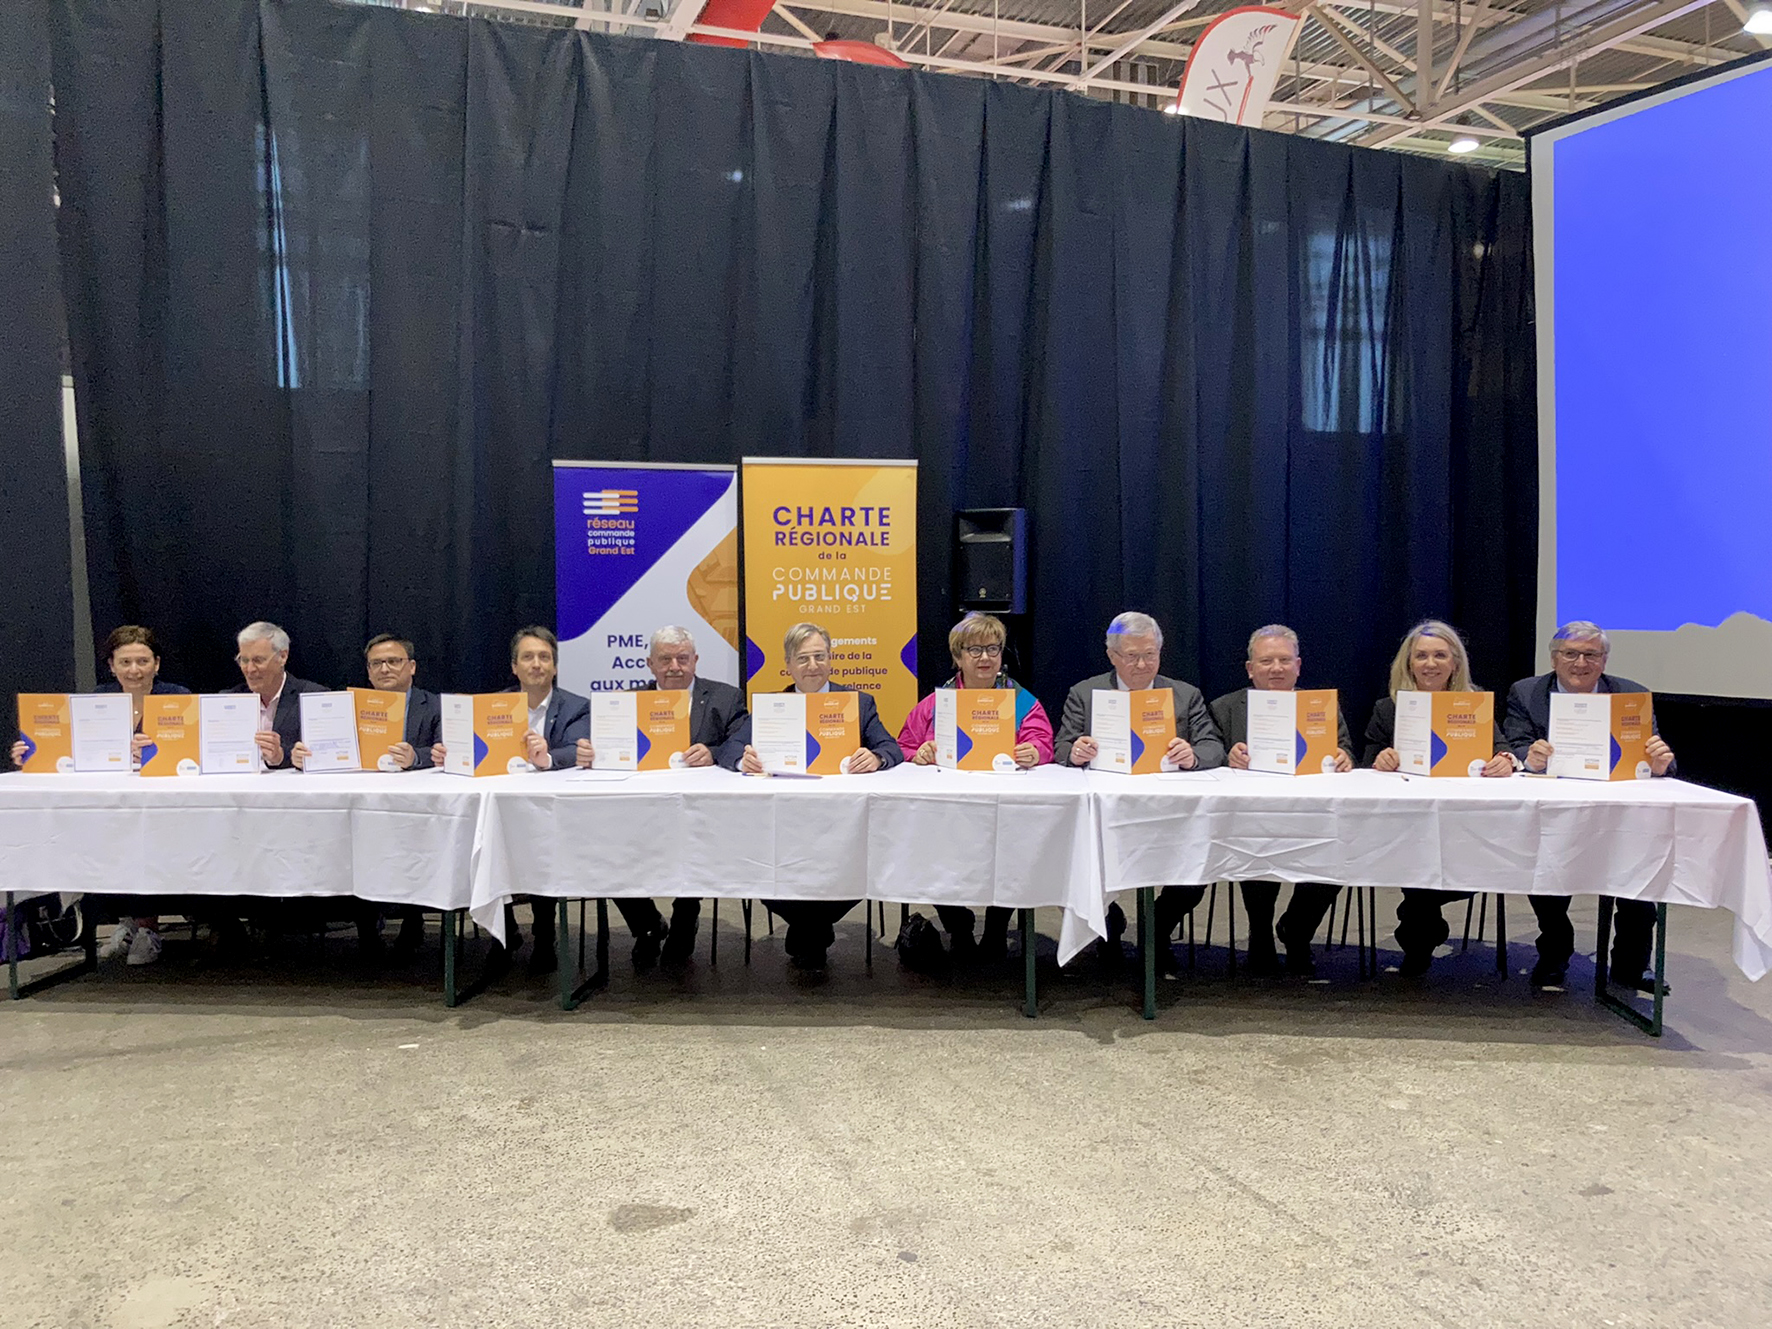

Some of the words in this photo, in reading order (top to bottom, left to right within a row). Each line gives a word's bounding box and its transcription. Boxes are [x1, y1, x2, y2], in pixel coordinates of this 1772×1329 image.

[773, 506, 891, 527] CHARTE
[587, 517, 635, 529] réseau
[774, 526, 890, 546] RÉGIONALE
[588, 538, 635, 547] publique
[588, 547, 619, 555] Grand
[620, 547, 635, 555] Est
[818, 551, 832, 560] de
[836, 551, 847, 560] la
[772, 567, 892, 581] COMMANDE
[772, 583, 892, 602] PUBLIQUE
[798, 604, 841, 614] GRAND
[846, 604, 866, 613] EST
[607, 634, 648, 650] PME,
[830, 637, 877, 648] gements
[829, 651, 845, 660] ire
[847, 652, 860, 660] de
[862, 651, 872, 660] la
[612, 656, 646, 669] Acc
[842, 666, 888, 677] publique
[590, 680, 624, 691] aux
